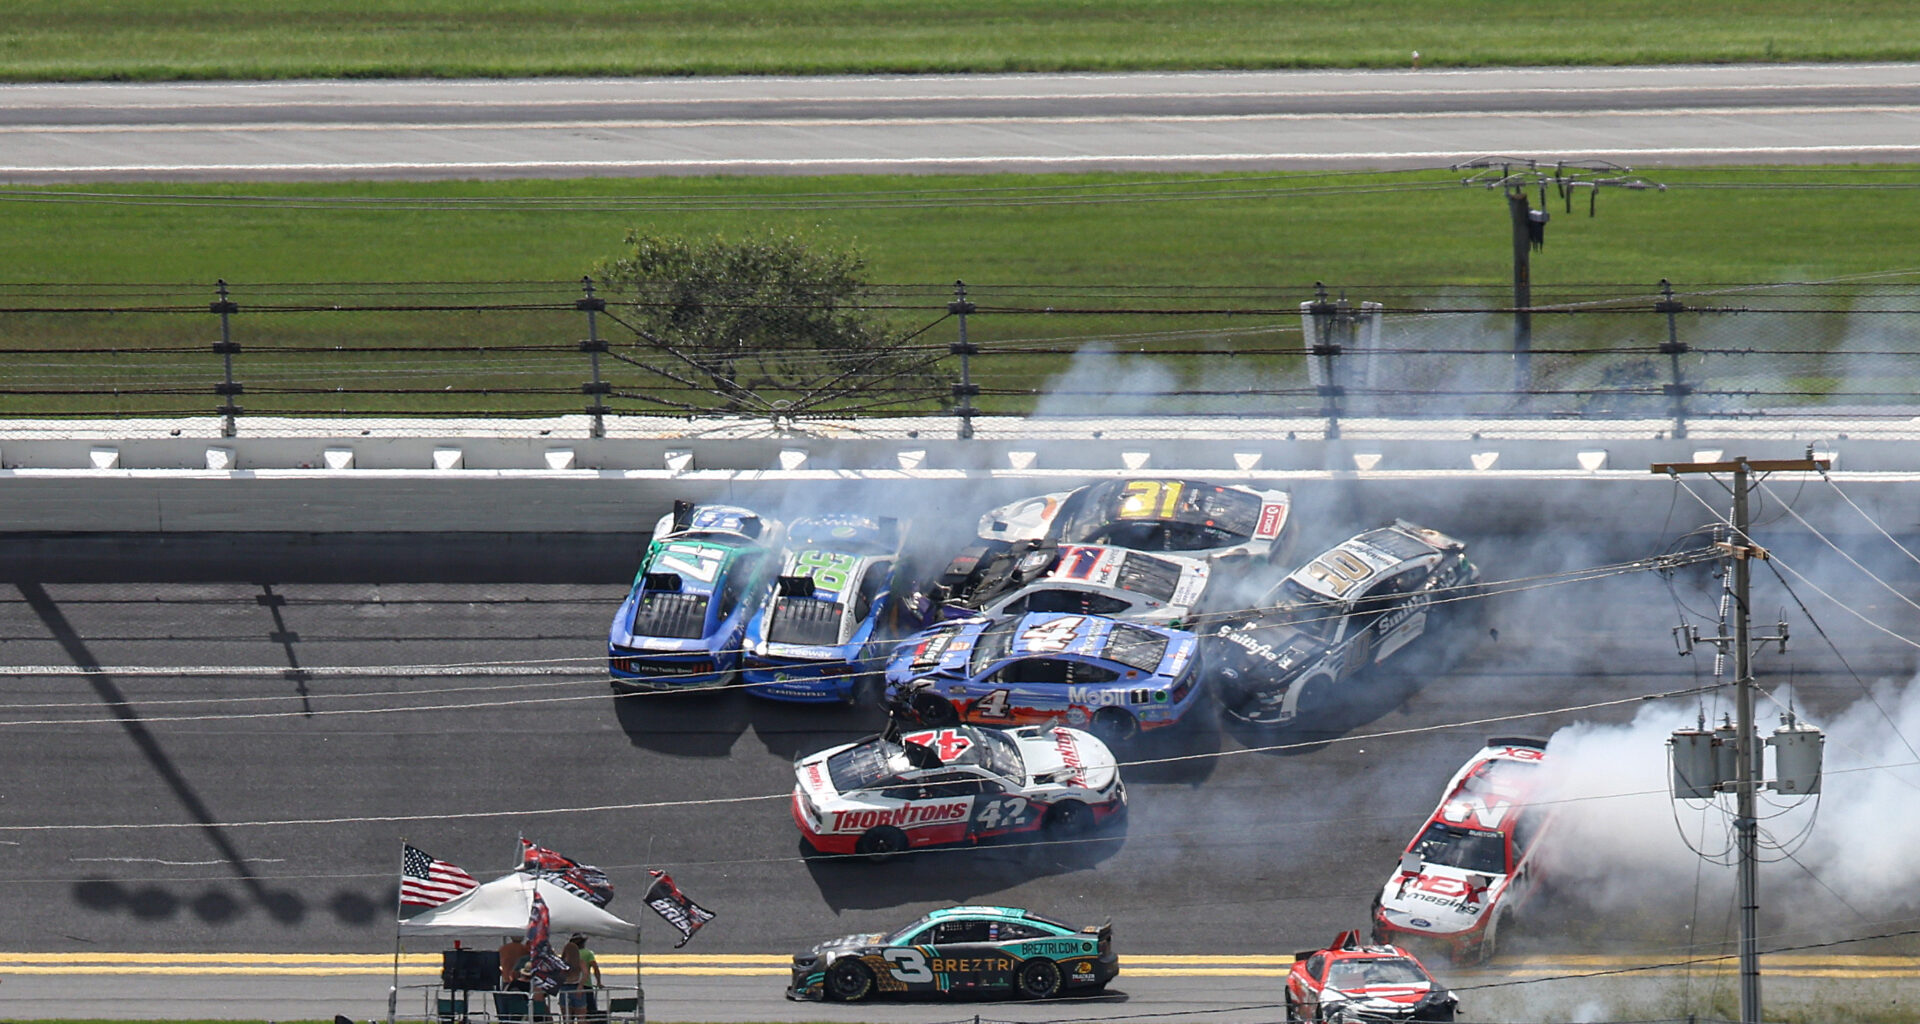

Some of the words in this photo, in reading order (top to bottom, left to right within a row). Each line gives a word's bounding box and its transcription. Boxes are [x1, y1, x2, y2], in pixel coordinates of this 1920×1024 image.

[1119, 480, 1184, 519] 31
[661, 544, 725, 583] 17
[1308, 549, 1375, 597] 10
[1022, 614, 1088, 652] 4
[976, 688, 1011, 718] 4
[1068, 687, 1125, 706] Mobil
[832, 802, 968, 832] THORNTONS
[976, 798, 1029, 830] 42
[1405, 891, 1480, 915] maging
[1021, 942, 1079, 955] BREZTRI.COM
[882, 948, 934, 983] 3
[932, 958, 1015, 972] BREZTRI
